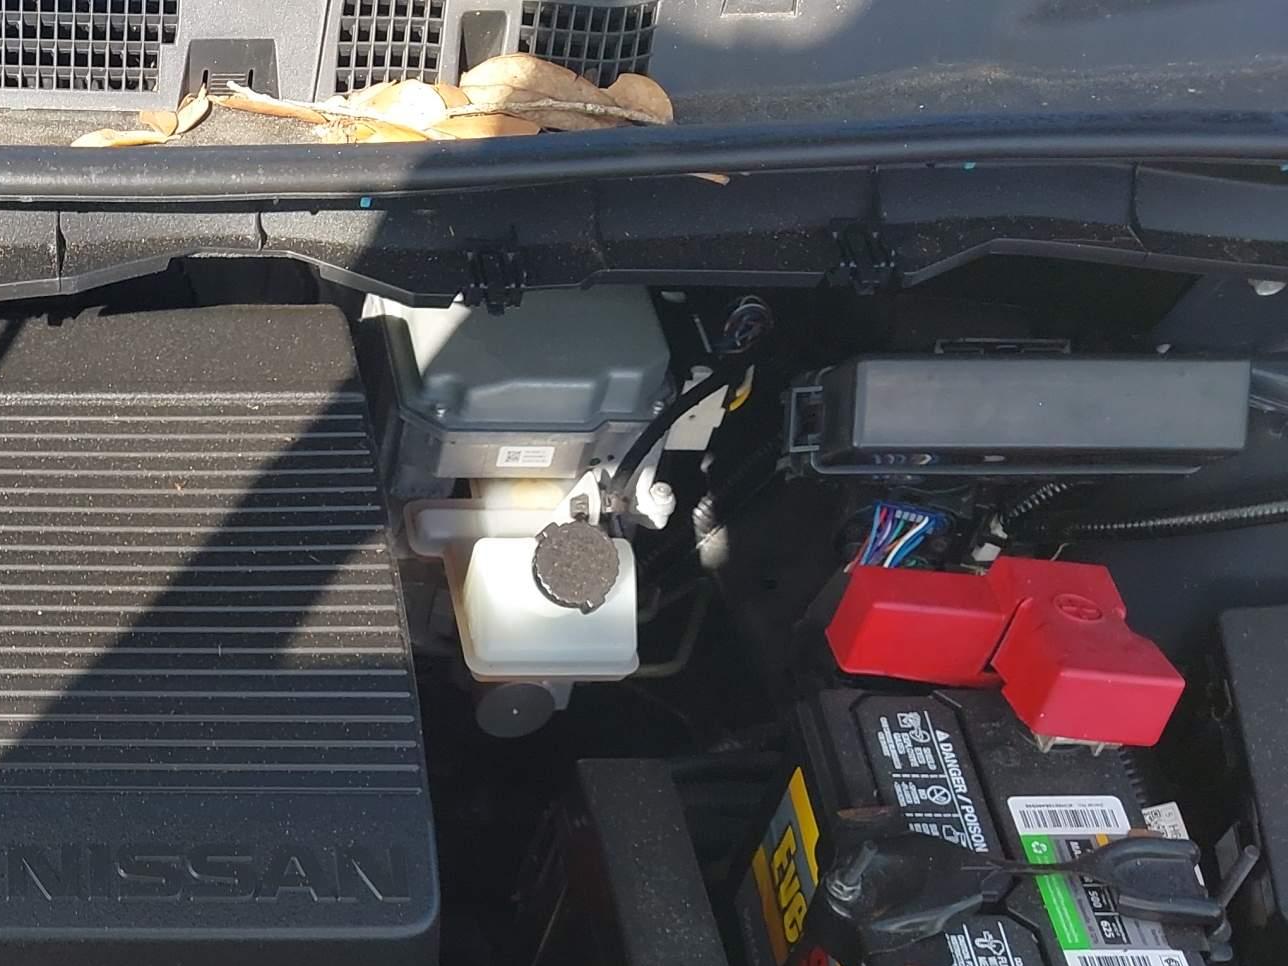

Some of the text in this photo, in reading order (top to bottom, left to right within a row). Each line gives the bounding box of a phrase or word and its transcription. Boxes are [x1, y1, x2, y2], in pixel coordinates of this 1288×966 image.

[941, 742, 968, 794] DANGER
[961, 805, 989, 853] POISON
[6, 846, 411, 902] NISSAN
[1099, 919, 1115, 939] 625
